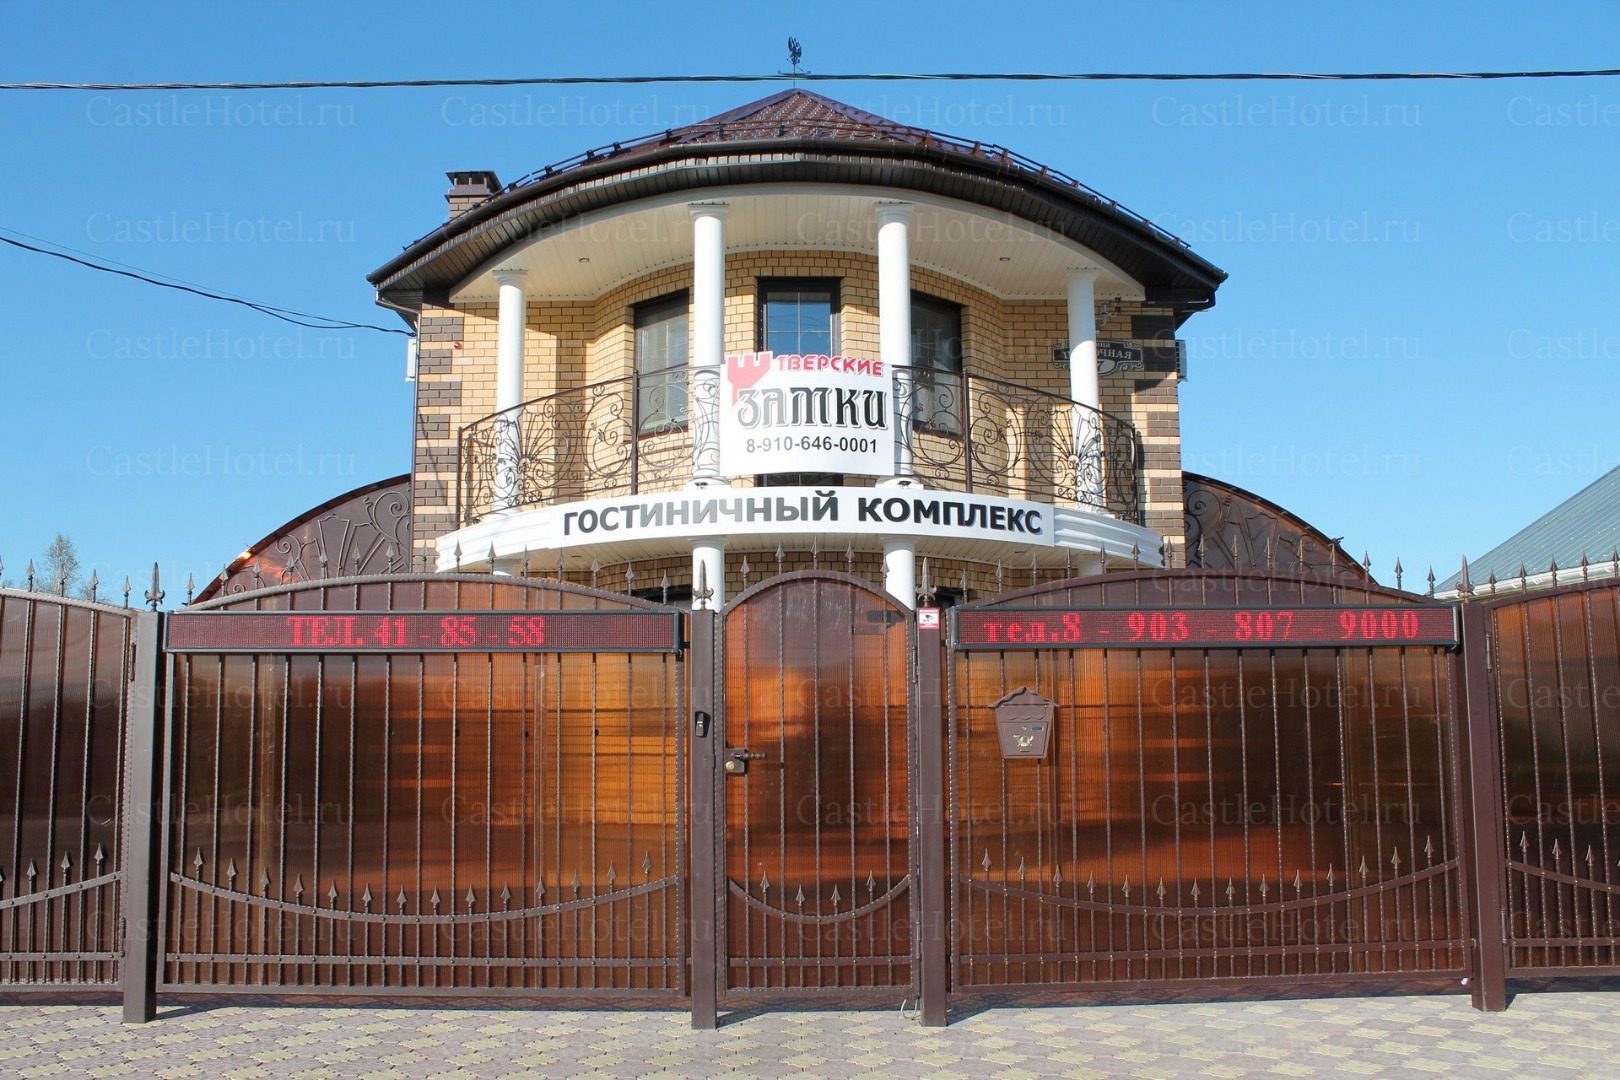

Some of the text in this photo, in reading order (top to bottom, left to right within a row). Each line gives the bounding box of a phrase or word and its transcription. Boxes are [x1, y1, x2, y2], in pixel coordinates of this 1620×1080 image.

[778, 355, 884, 376] ТВЕРСКИЕ
[738, 387, 887, 429] ЗАМКИ
[746, 436, 877, 453] 8-910-646-0001
[564, 490, 1043, 536] ГОСТИНИЧНЫЙ КОМПЛЕКС
[287, 616, 364, 646] ТЕЛ.
[373, 616, 408, 646] 41
[440, 616, 477, 646] 85
[508, 616, 545, 646] 58
[1128, 612, 1189, 641] 903
[1235, 610, 1294, 640] 807
[1340, 610, 1419, 640] 9000
